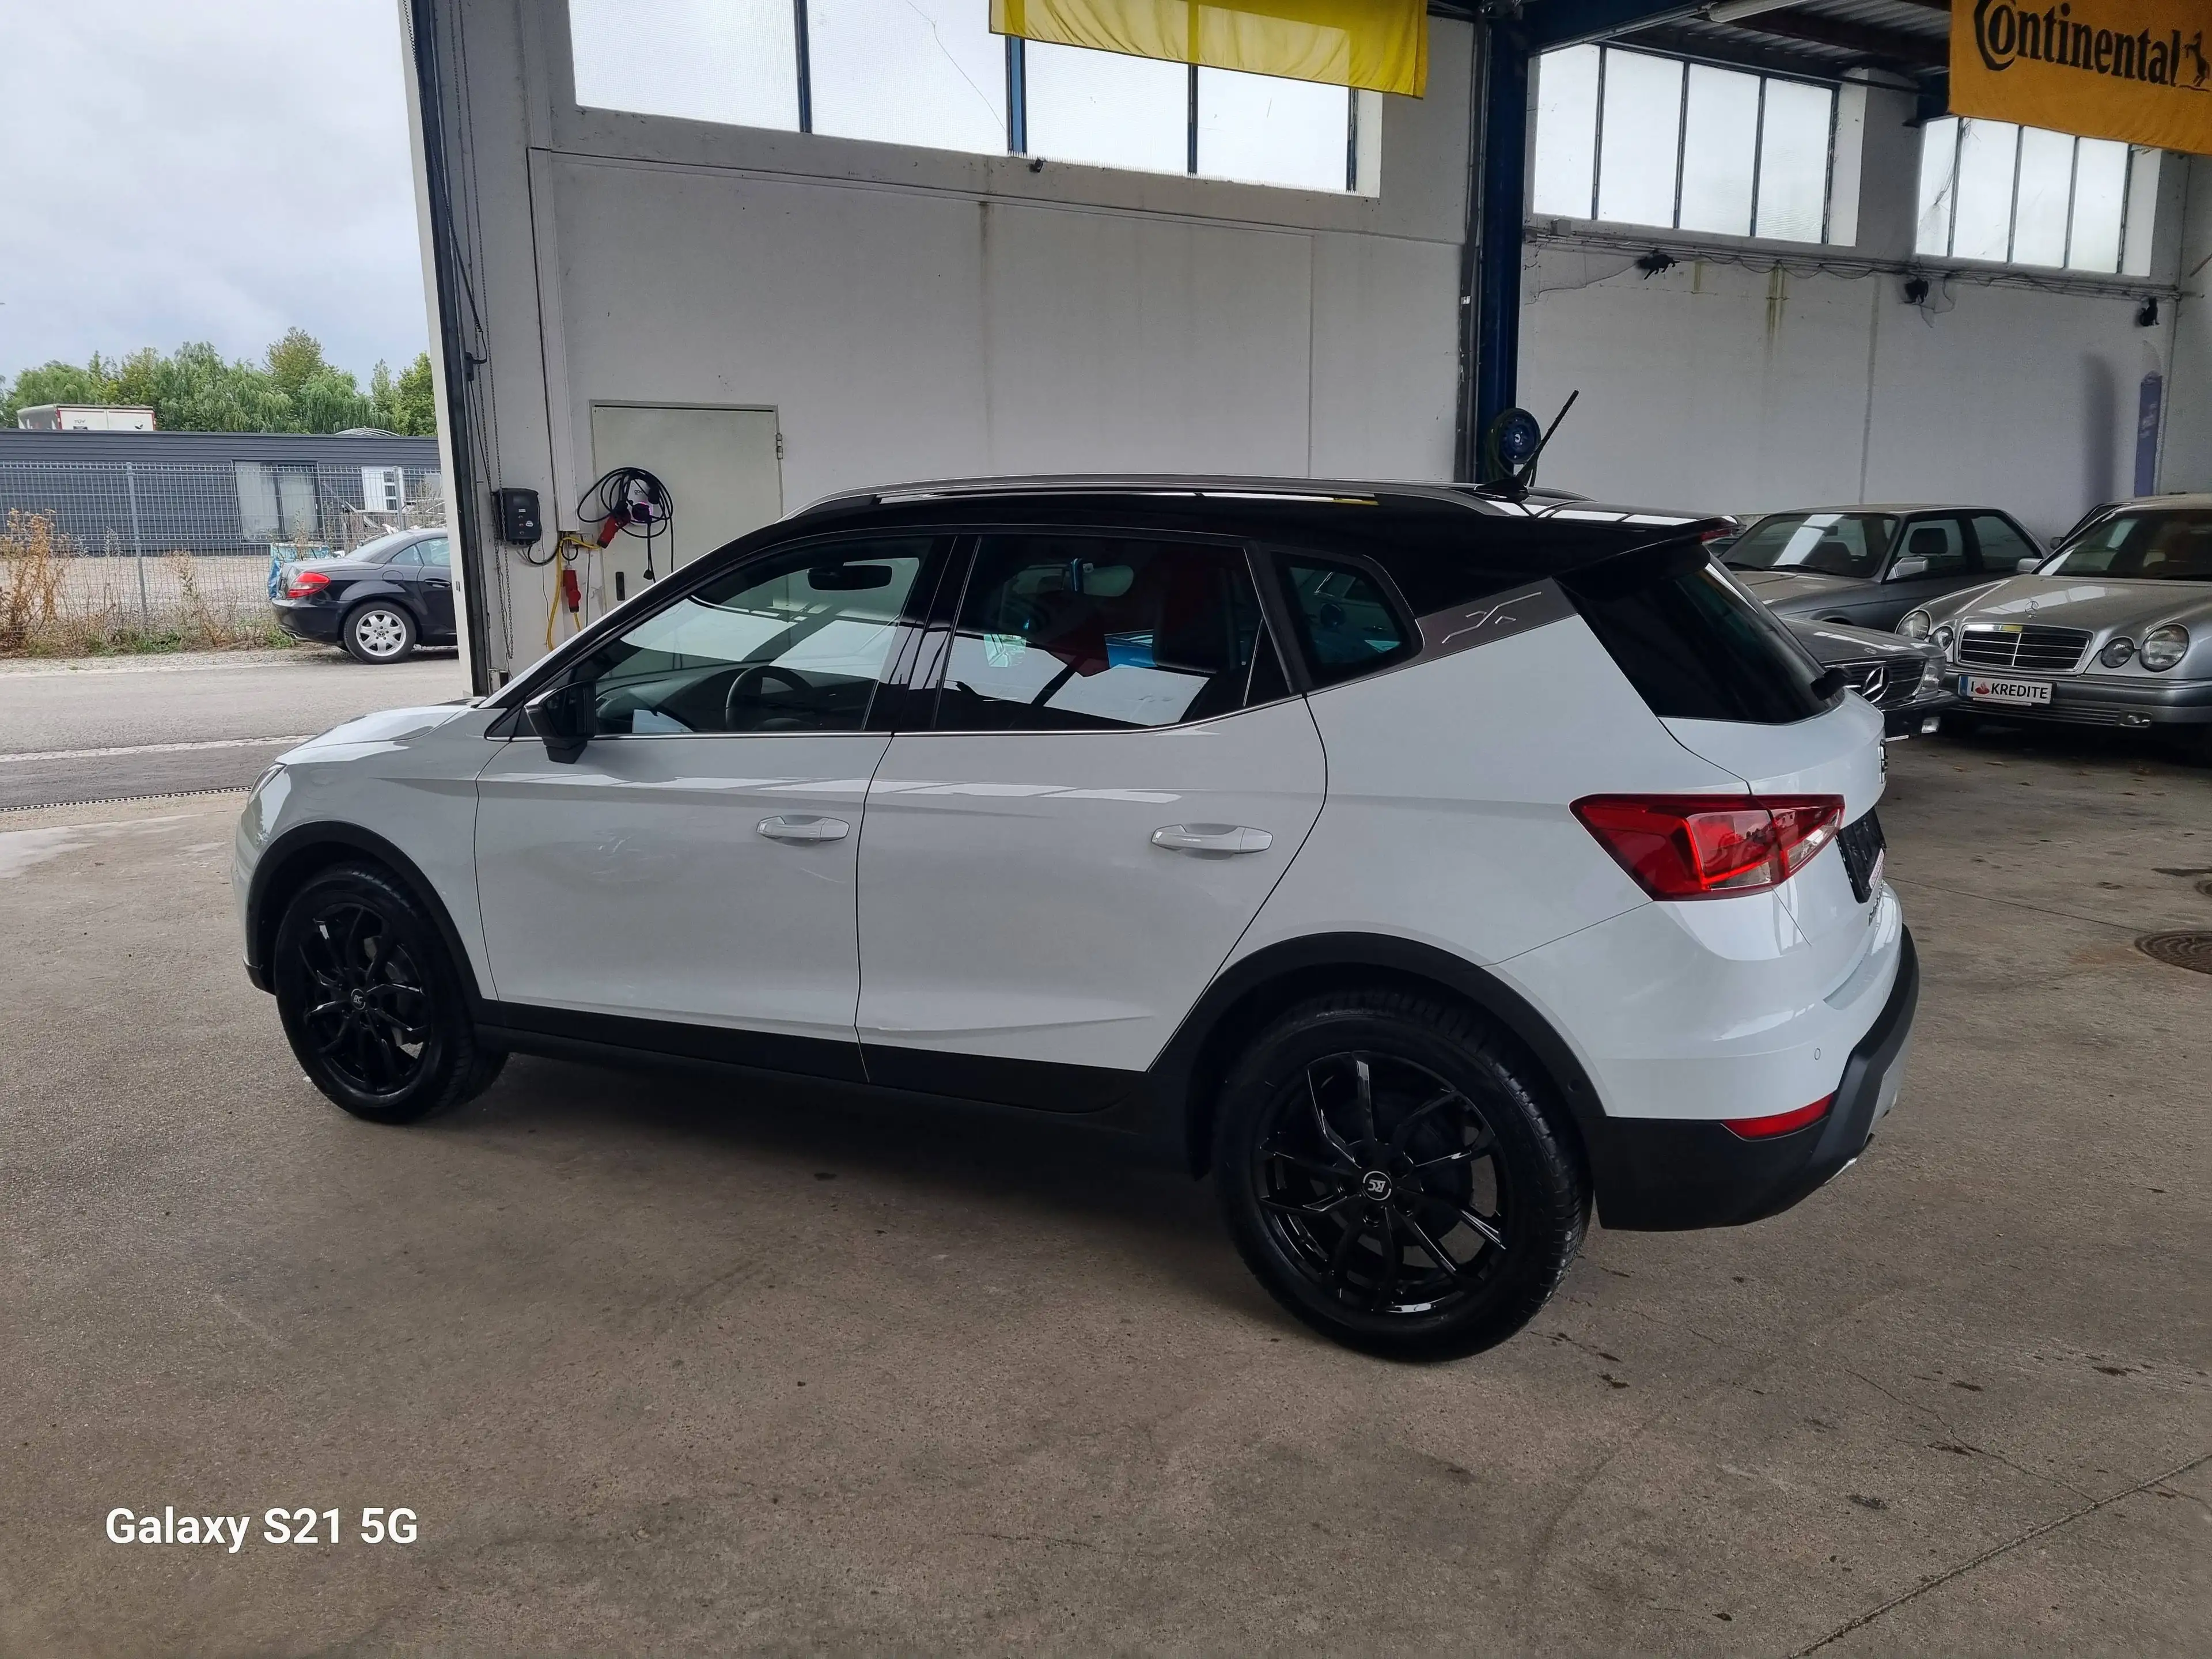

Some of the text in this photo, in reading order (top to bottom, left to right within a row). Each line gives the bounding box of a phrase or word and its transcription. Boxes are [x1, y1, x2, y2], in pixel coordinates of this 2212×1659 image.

[1974, 0, 2181, 87] Continental
[1971, 681, 2048, 699] I KREDITE
